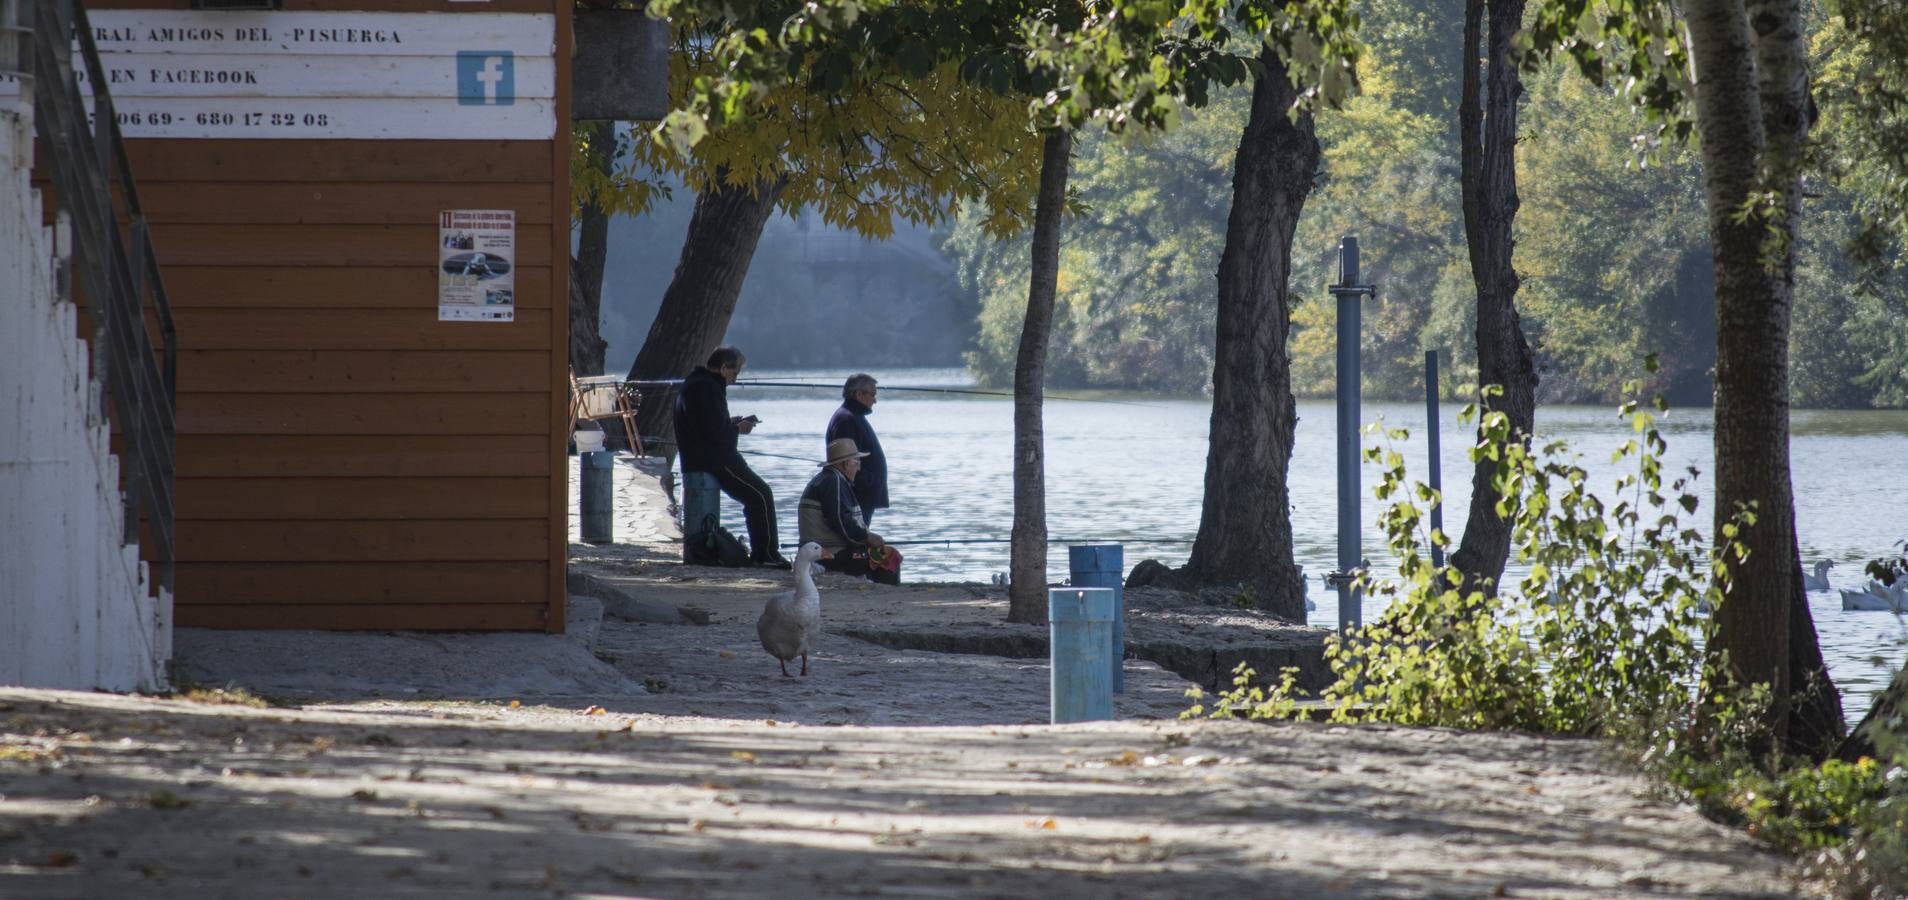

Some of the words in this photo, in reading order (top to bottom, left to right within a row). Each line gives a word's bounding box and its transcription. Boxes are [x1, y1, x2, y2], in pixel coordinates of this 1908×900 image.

[148, 27, 225, 42] AMIGOS
[235, 28, 272, 42] DEL
[293, 28, 402, 44] PISUERGA
[111, 69, 136, 84] EN
[150, 69, 258, 84] FACEBOOK
[118, 112, 142, 126] 06
[148, 112, 173, 126] 69
[196, 112, 234, 126] 680
[244, 112, 263, 127] 17
[271, 113, 296, 127] 82
[303, 113, 329, 127] 08
